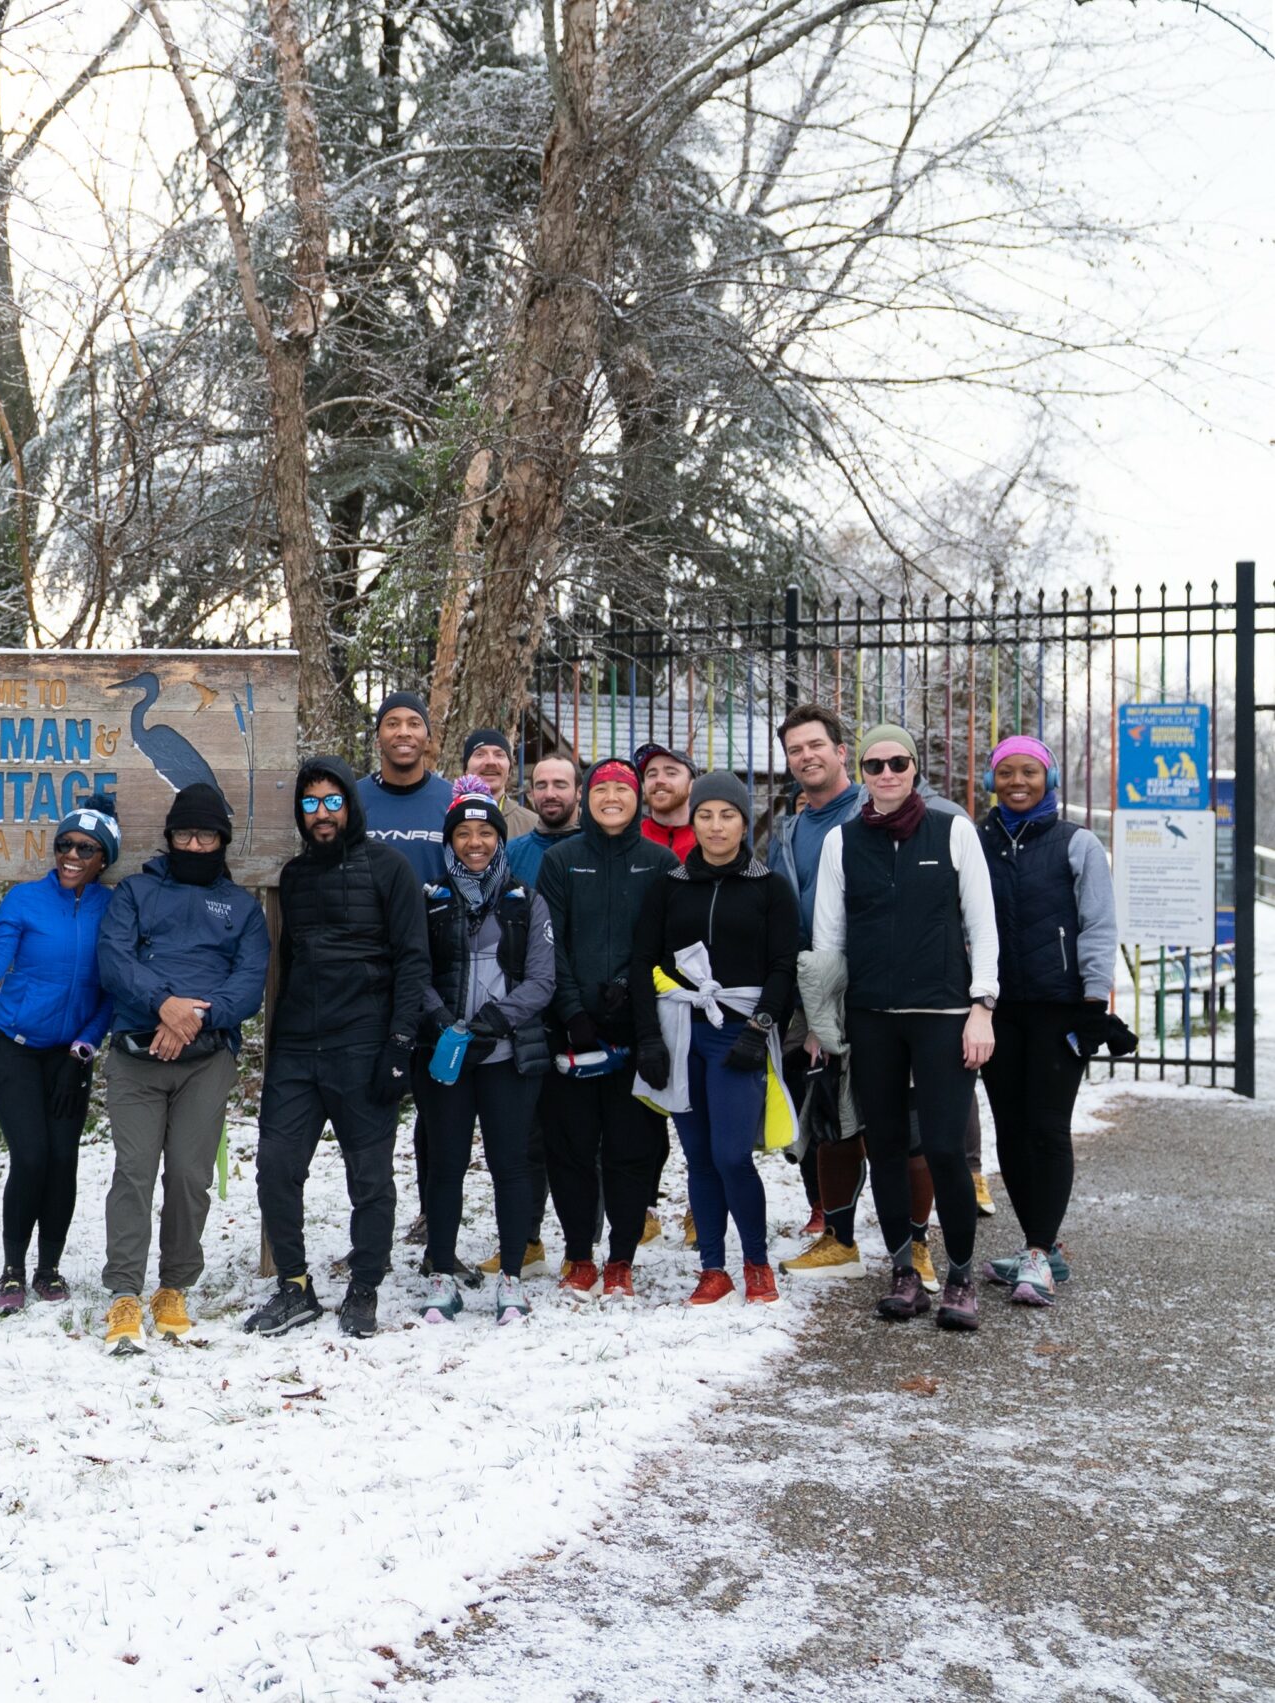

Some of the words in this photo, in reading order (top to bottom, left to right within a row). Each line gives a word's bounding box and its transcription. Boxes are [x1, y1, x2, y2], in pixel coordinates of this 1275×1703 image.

[35, 679, 67, 709] TO
[95, 724, 122, 759] &
[1147, 778, 1172, 787] KEEP
[1147, 786, 1190, 796] LEASHED
